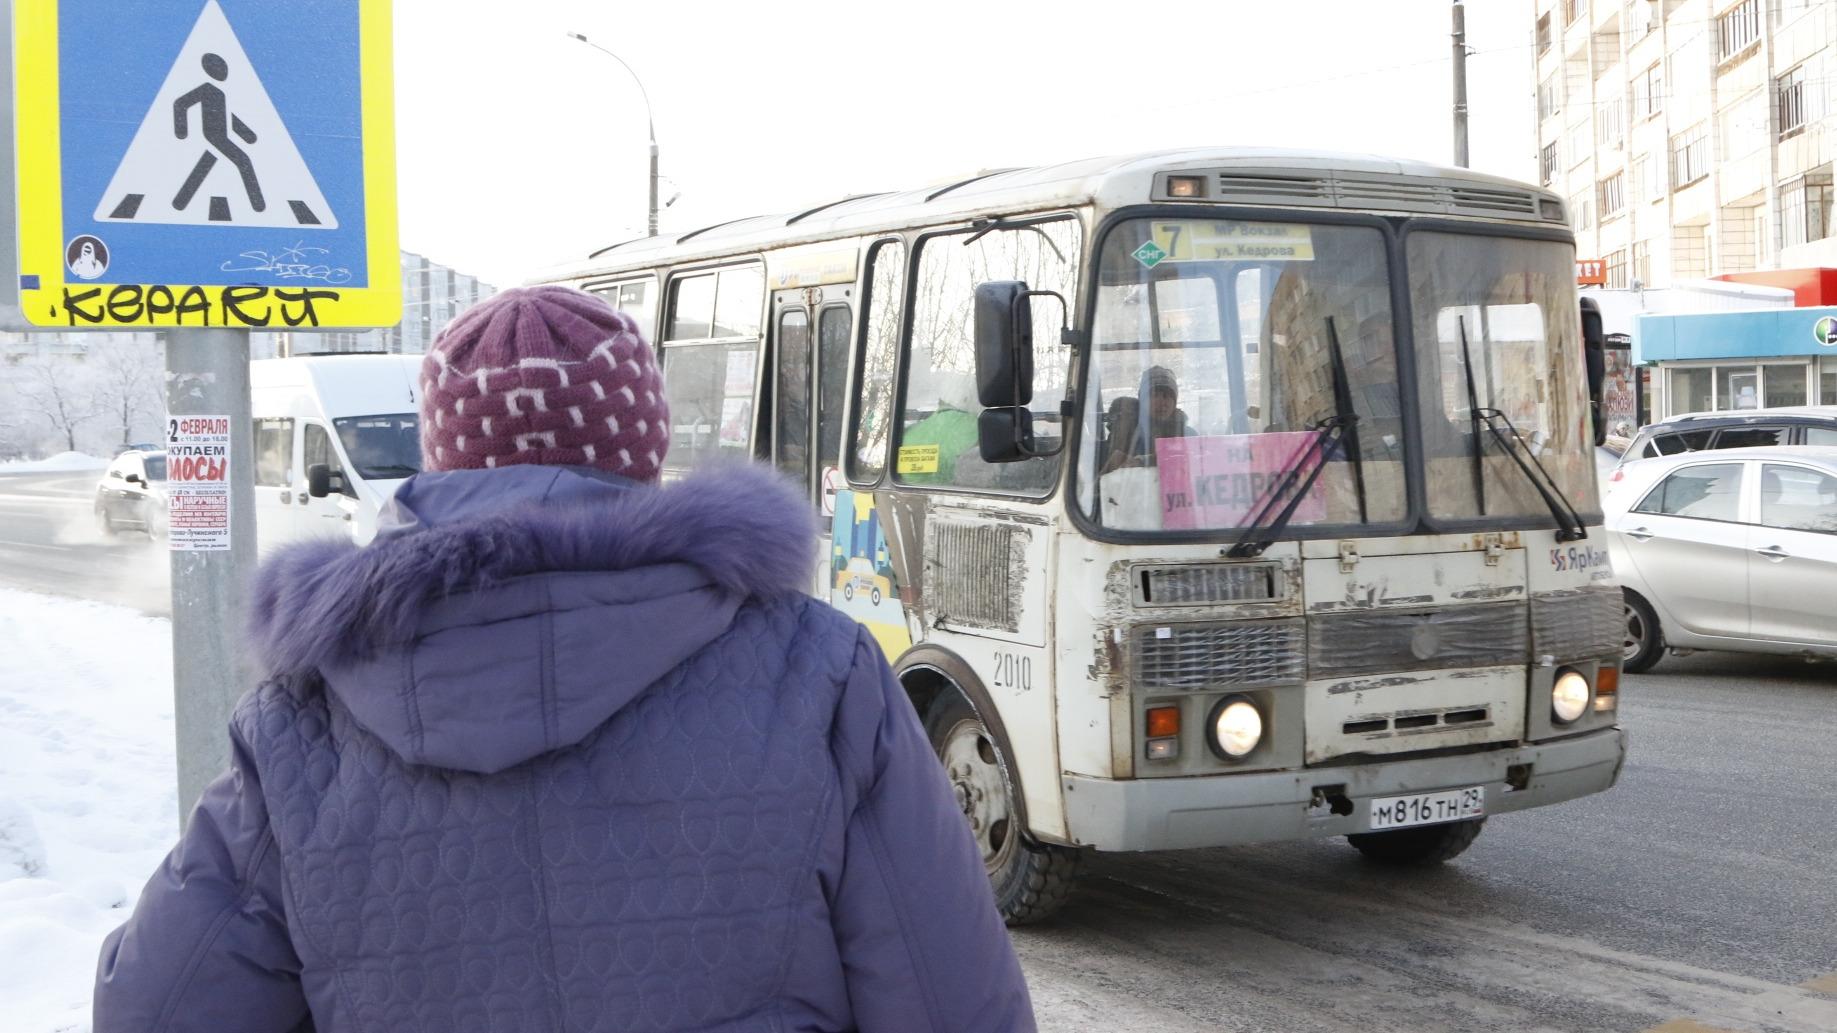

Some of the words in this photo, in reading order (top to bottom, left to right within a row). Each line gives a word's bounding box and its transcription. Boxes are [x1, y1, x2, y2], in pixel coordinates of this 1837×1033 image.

[1161, 225, 1182, 258] 7
[1214, 246, 1234, 258] ул.
[1237, 244, 1296, 257] Кедрова
[180, 418, 228, 434] ФЕВРАЛЯ
[1167, 493, 1192, 512] ул.
[994, 651, 1032, 691] 2010
